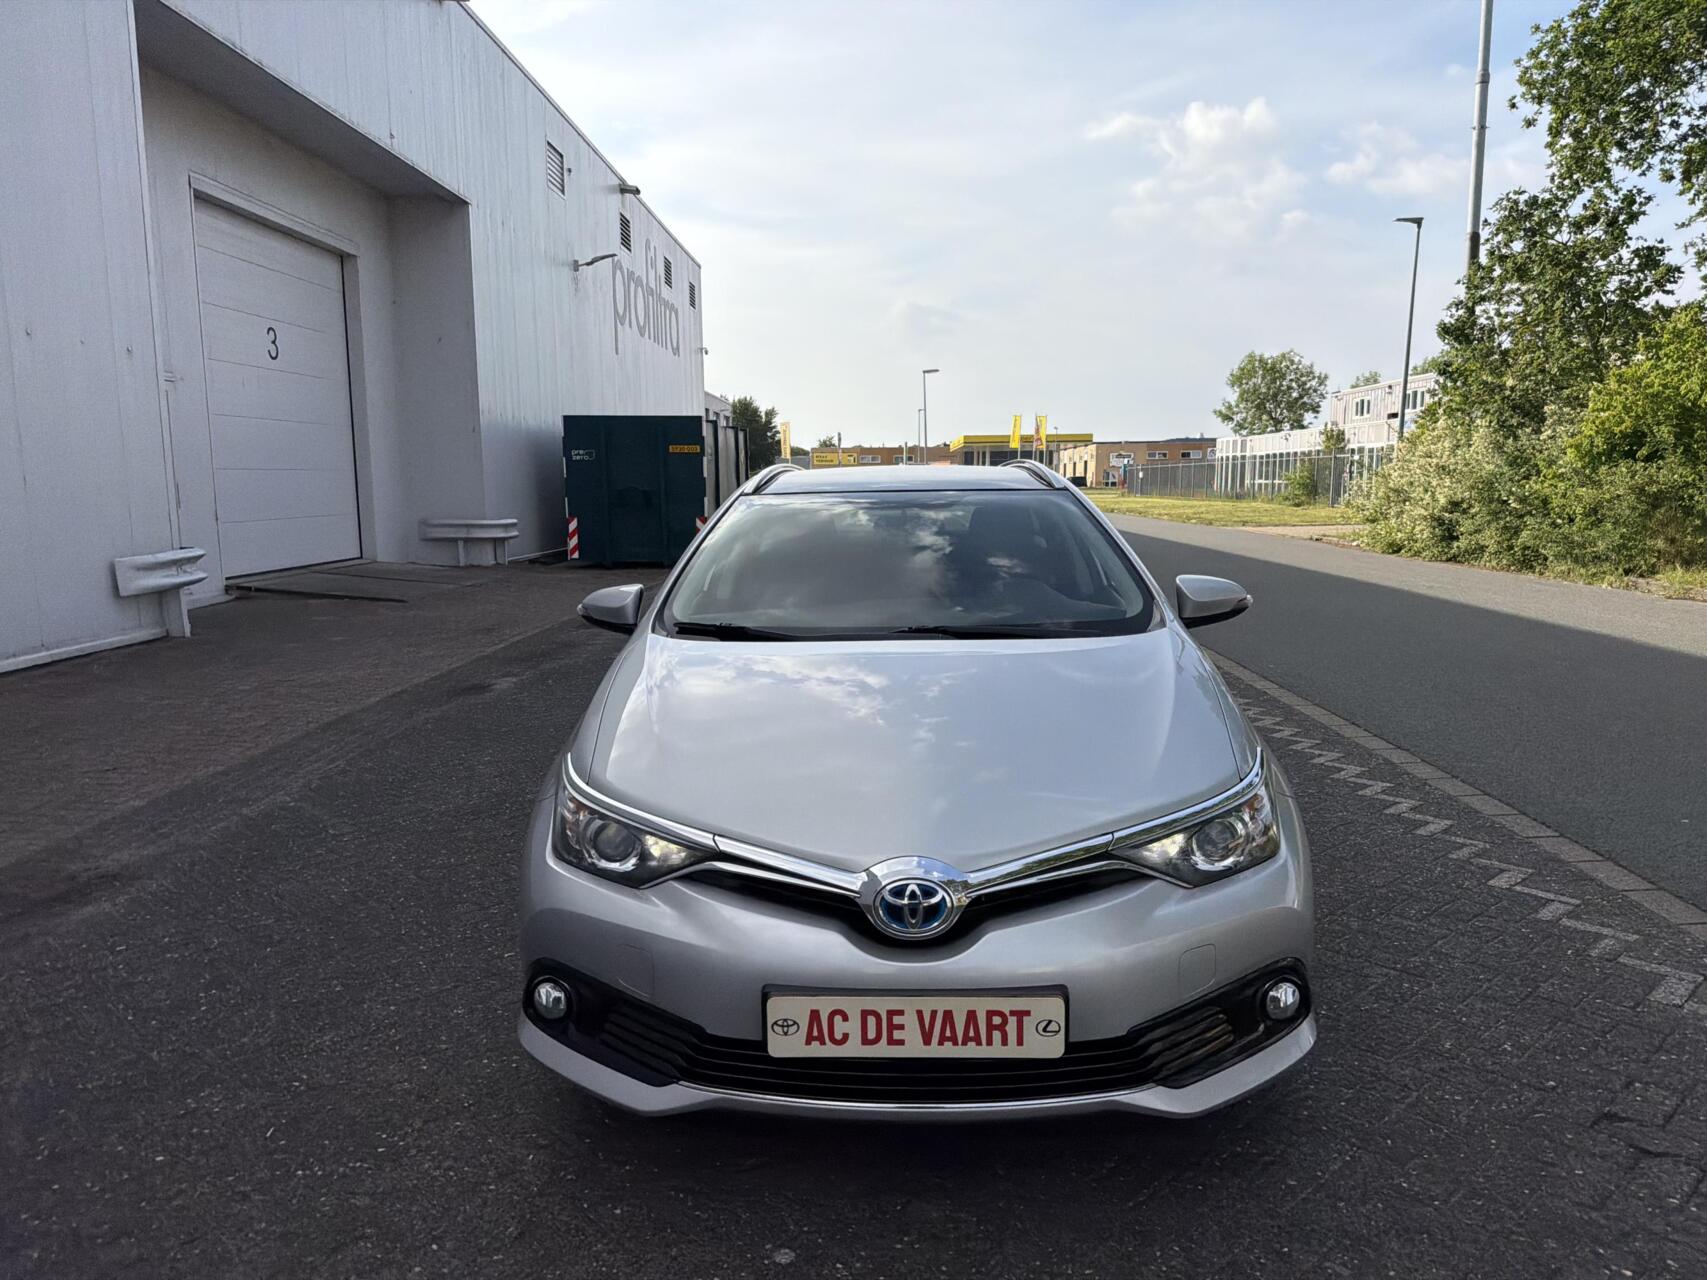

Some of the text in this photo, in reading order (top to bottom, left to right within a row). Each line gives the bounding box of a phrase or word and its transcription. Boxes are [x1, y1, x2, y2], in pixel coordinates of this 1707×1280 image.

[266, 326, 279, 361] 3
[804, 1008, 1032, 1047] AC DE VAART
